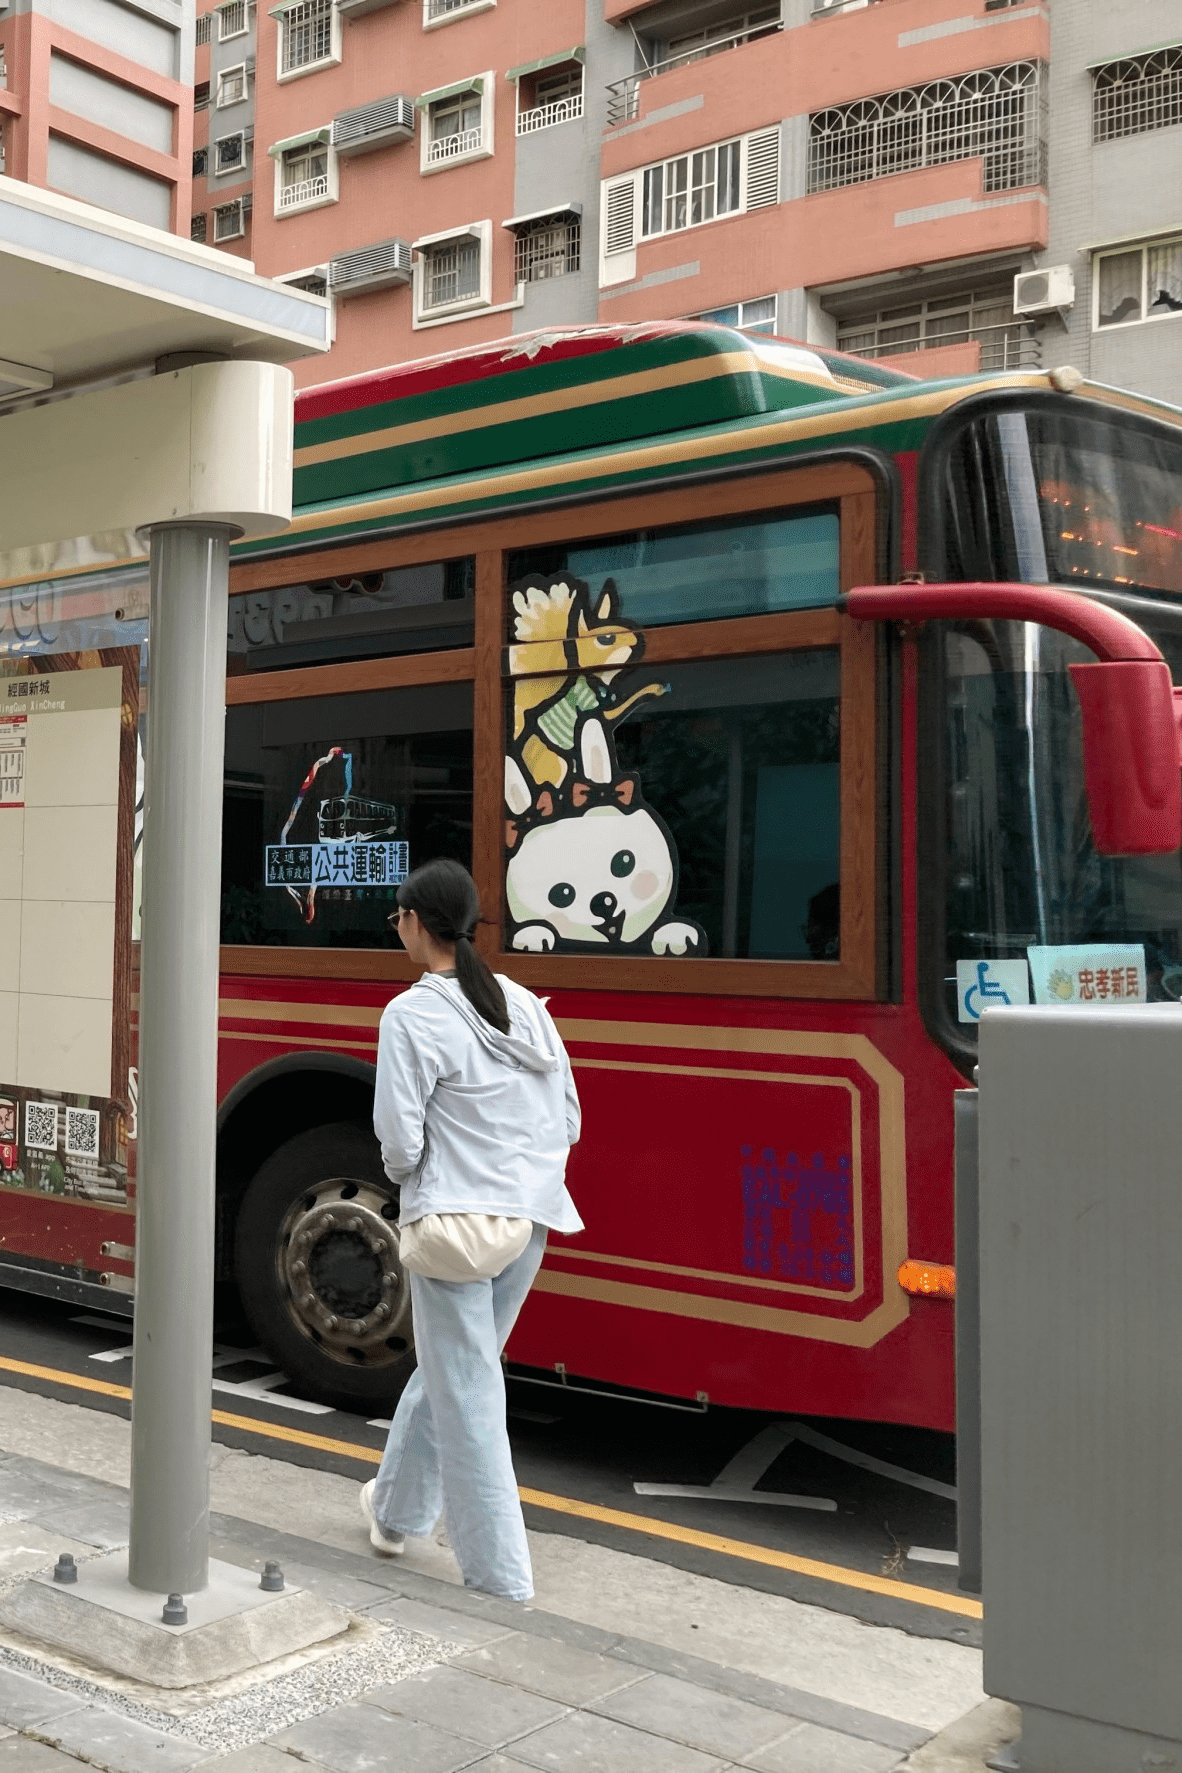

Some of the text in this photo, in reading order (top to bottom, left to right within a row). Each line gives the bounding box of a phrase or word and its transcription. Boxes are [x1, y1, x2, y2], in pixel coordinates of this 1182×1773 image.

[7, 679, 51, 698] 經國新城
[30, 699, 66, 712] XinCheng
[271, 848, 309, 864] 交通部
[268, 865, 311, 881] 嘉義市政府
[1078, 966, 1139, 1000] 忠孝新民
